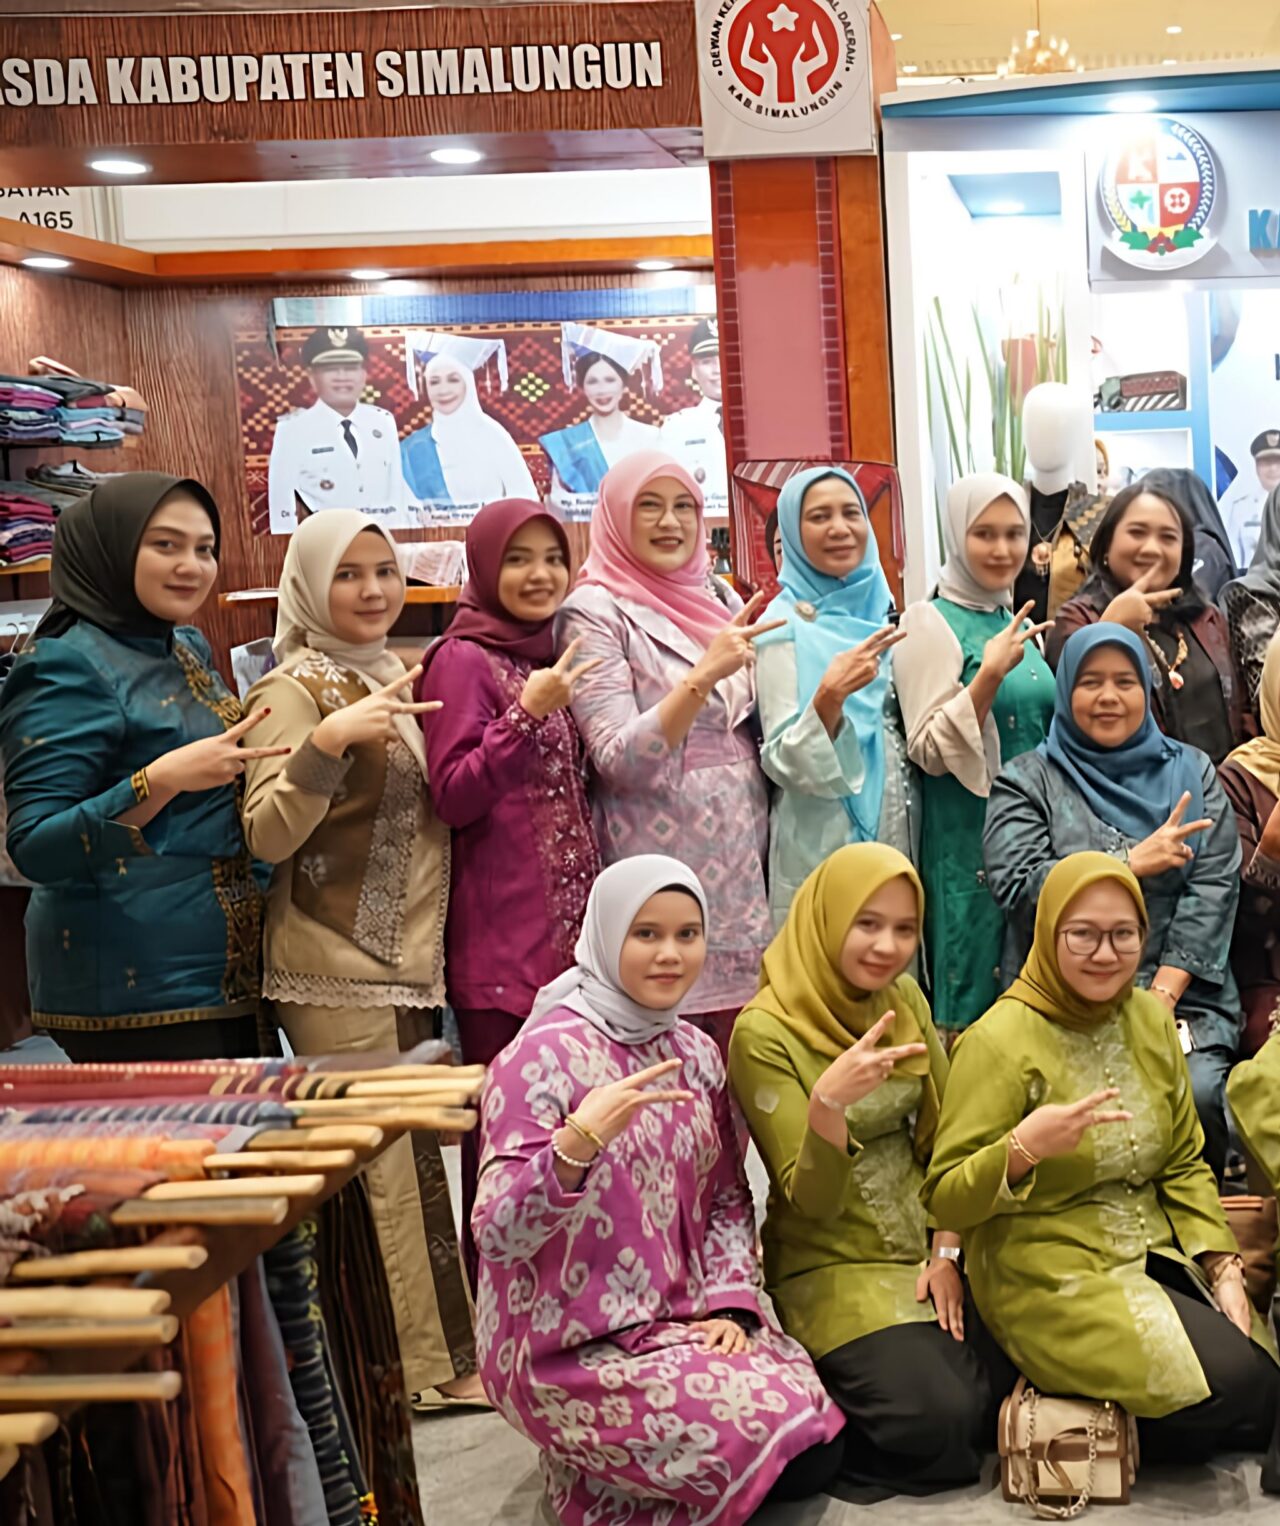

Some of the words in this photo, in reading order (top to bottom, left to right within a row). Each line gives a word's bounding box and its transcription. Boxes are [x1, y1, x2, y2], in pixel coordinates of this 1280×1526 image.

[0, 57, 99, 107] SDA
[106, 51, 365, 104] KABUPATEN
[375, 42, 663, 98] SIMALUNGUN
